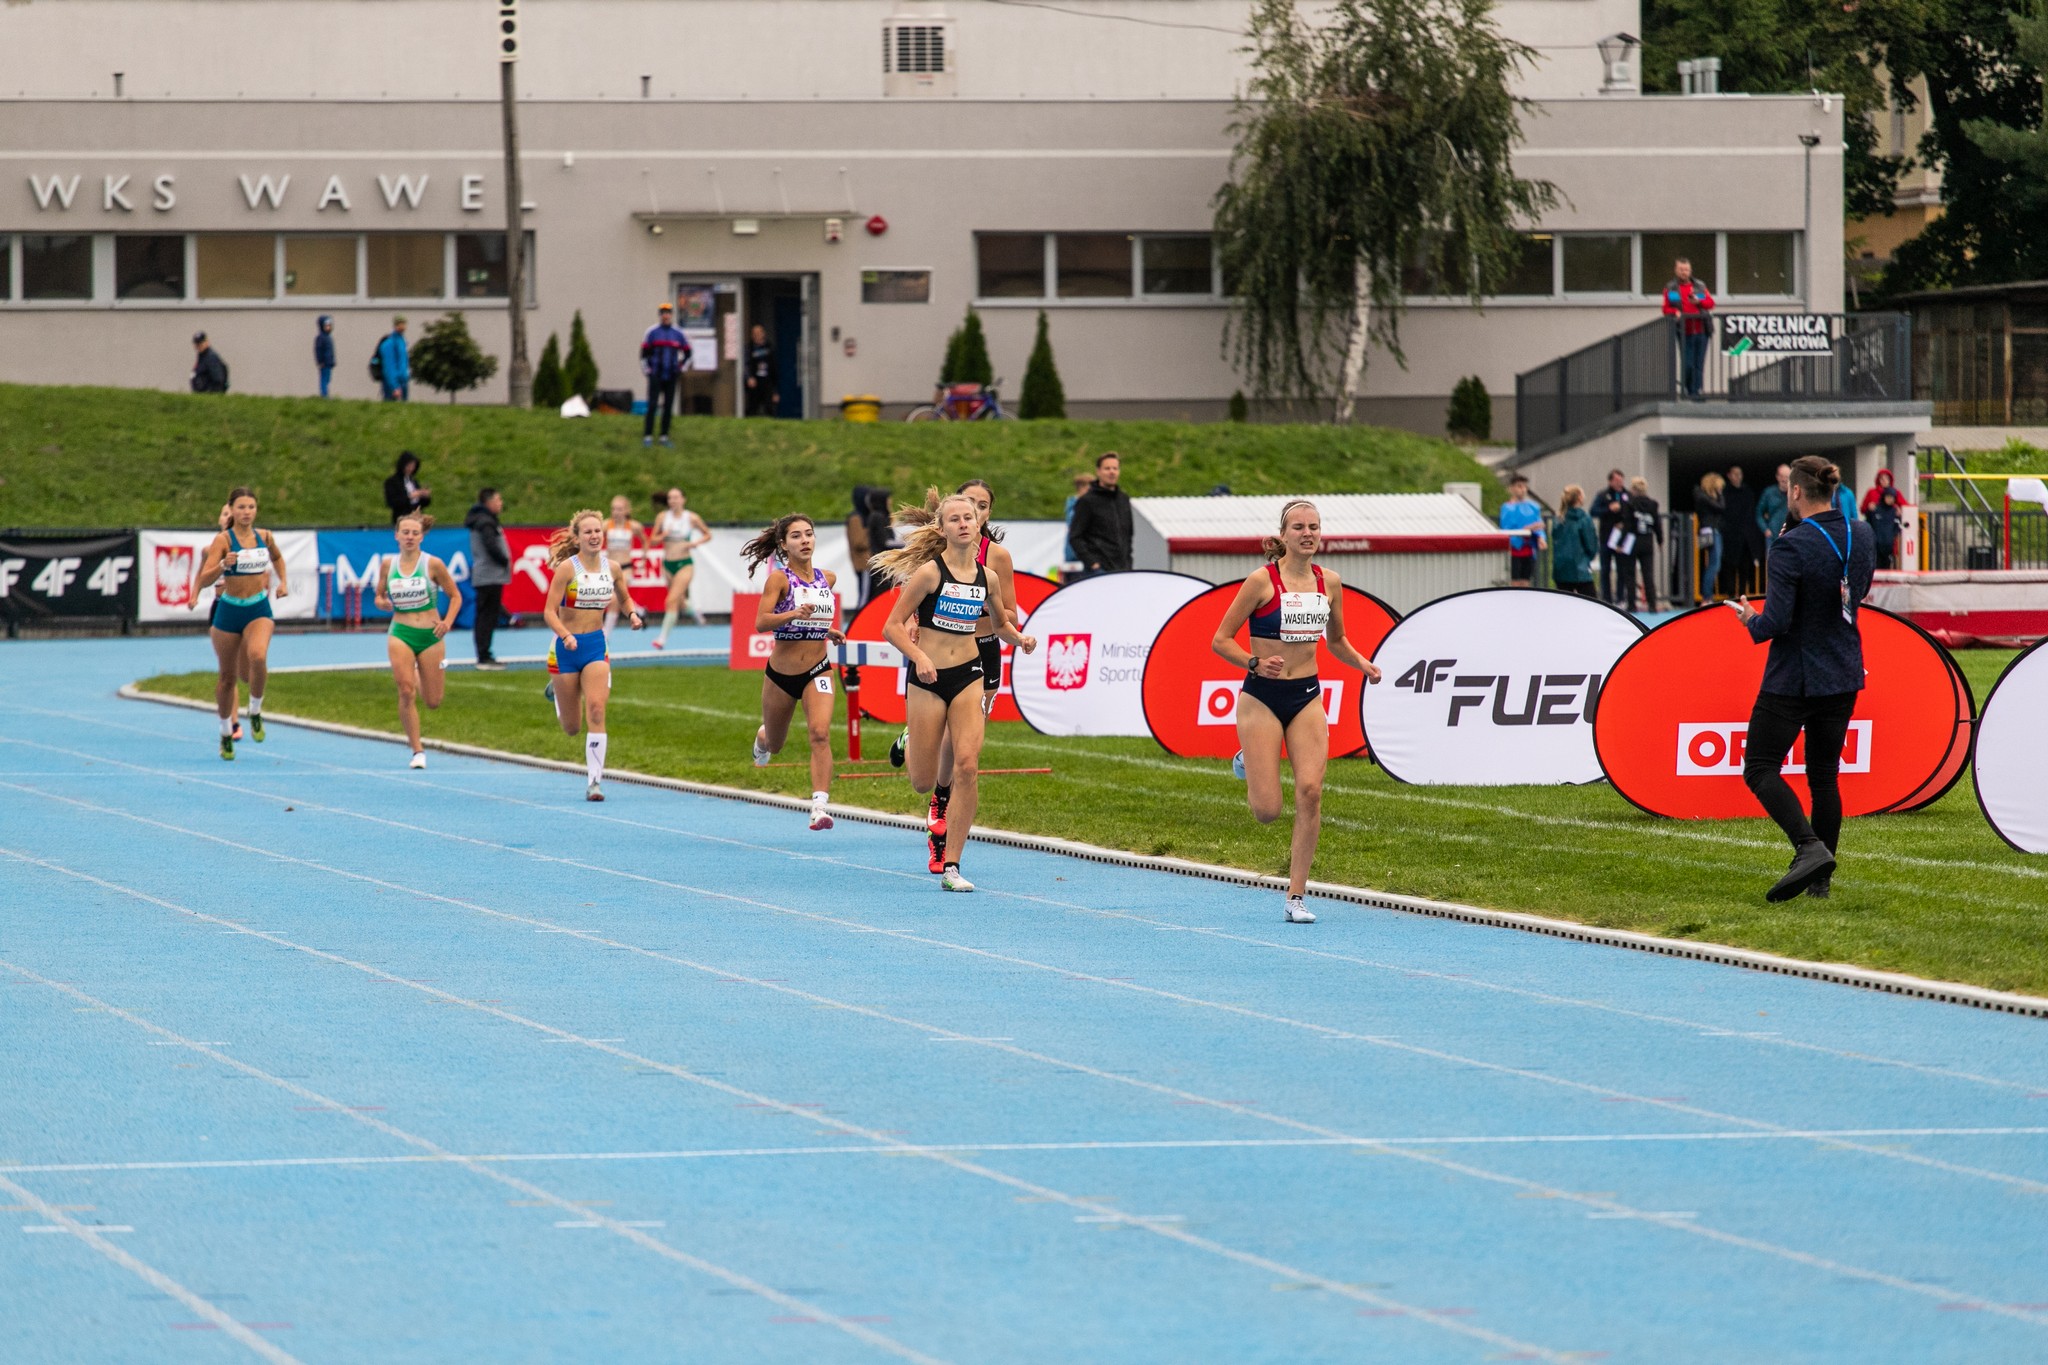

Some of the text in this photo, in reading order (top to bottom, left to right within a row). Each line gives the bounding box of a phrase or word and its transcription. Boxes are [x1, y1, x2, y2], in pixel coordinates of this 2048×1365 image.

[29, 174, 538, 211] WKS WAWE
[1725, 315, 1829, 335] STRZELNICA
[1757, 335, 1830, 350] SPORTOWA
[0, 556, 134, 598] F 4F 4F
[818, 589, 830, 599] 49
[969, 587, 981, 599] 12
[1316, 594, 1322, 606] 7
[937, 620, 965, 631] KRAKÓW
[778, 631, 803, 639] PRO
[1285, 634, 1313, 642] KRAKÓW
[809, 663, 822, 676] NIKE
[1394, 659, 1458, 693] 4F
[819, 679, 828, 690] 8
